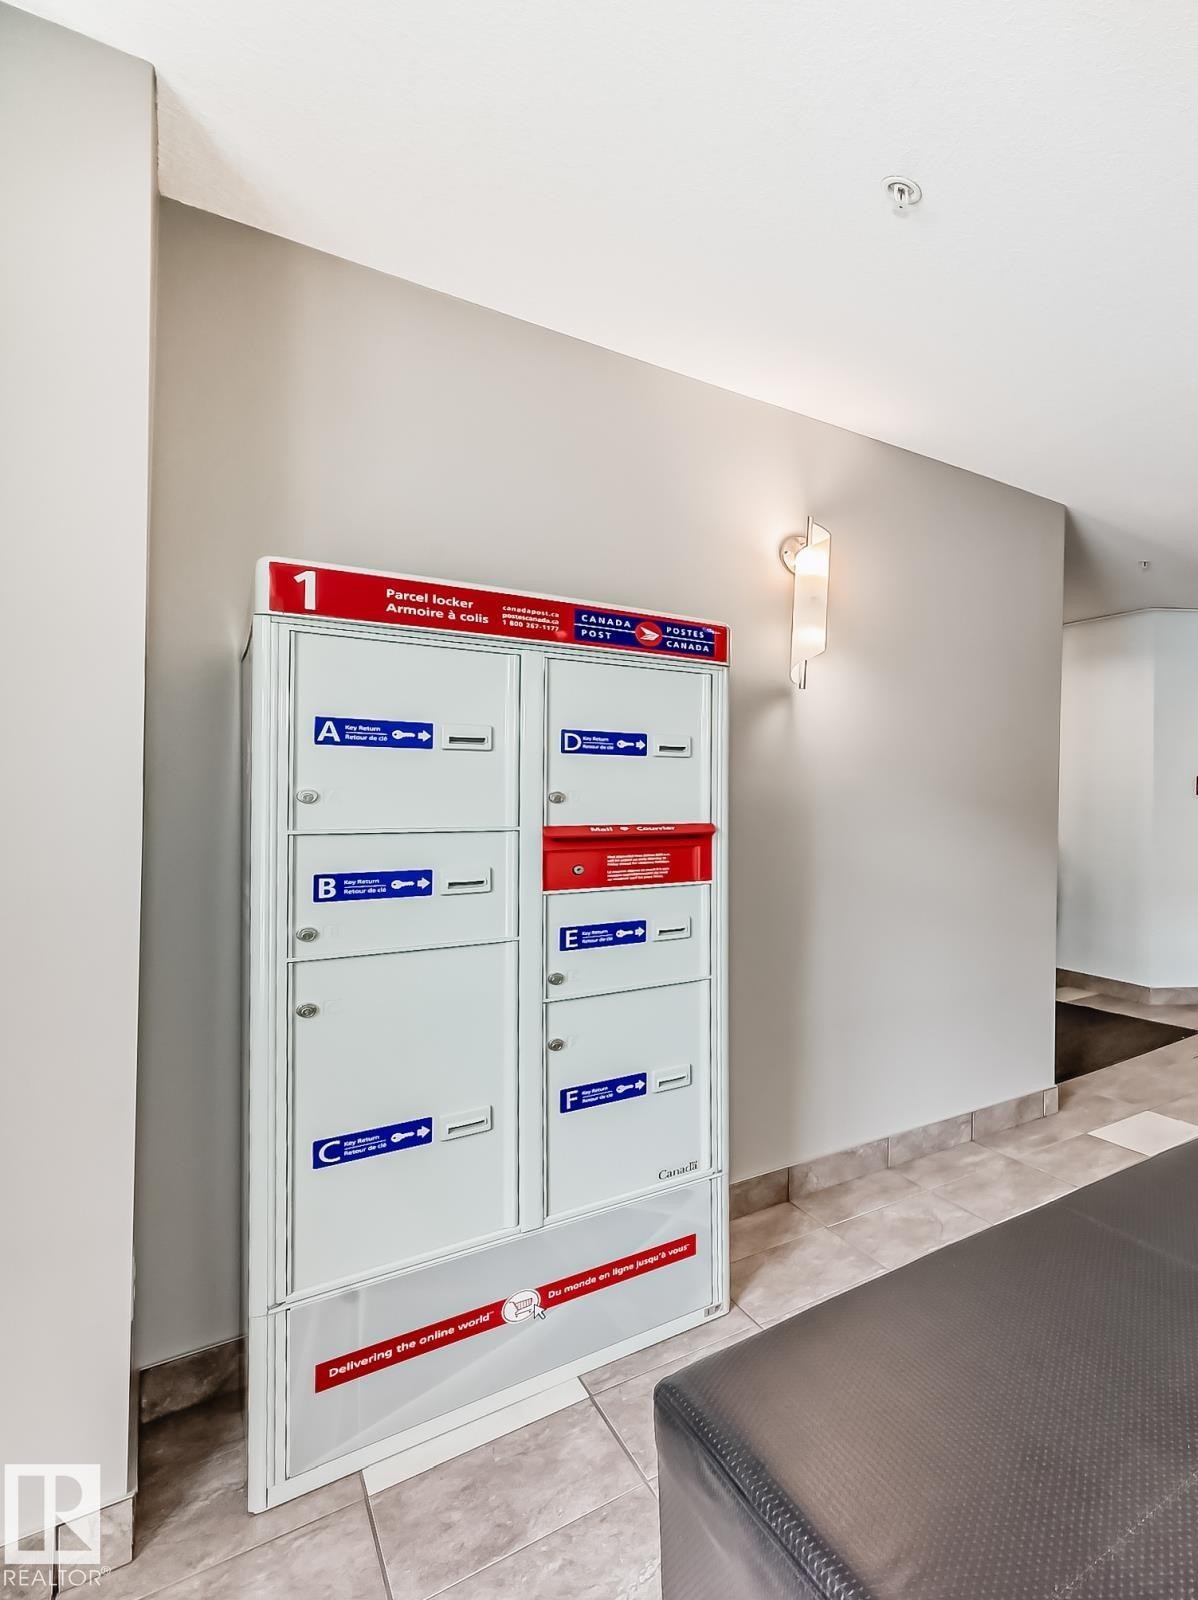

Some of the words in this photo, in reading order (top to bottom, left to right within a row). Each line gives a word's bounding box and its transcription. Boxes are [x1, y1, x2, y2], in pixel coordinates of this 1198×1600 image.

[293, 570, 317, 611] 1
[386, 588, 428, 603] Parcel
[432, 594, 474, 608] locker
[385, 603, 444, 618] Armoire
[448, 610, 456, 620] à
[460, 612, 489, 624] colis
[502, 605, 560, 618] canadapost.ca
[502, 613, 560, 625] postescanada.ca
[581, 614, 631, 628] CANADA
[526, 622, 560, 632] 267-1177
[581, 629, 612, 640] POST
[666, 626, 705, 638] POSTES
[666, 640, 709, 652] CANADA
[316, 720, 341, 742] A
[564, 732, 581, 751] D
[318, 878, 337, 899] B
[565, 930, 578, 948] E
[566, 1089, 579, 1110] F
[318, 1140, 341, 1163] C
[658, 1160, 698, 1180] Canada
[548, 1289, 562, 1299] Du
[564, 1275, 597, 1293] monde
[598, 1271, 611, 1281] en
[612, 1263, 634, 1277] ligne
[635, 1251, 667, 1270] jusqu'à
[668, 1245, 688, 1256] vous
[328, 1349, 393, 1378] Delivering
[396, 1339, 417, 1353] the
[419, 1326, 455, 1345] online
[457, 1312, 490, 1331] world
